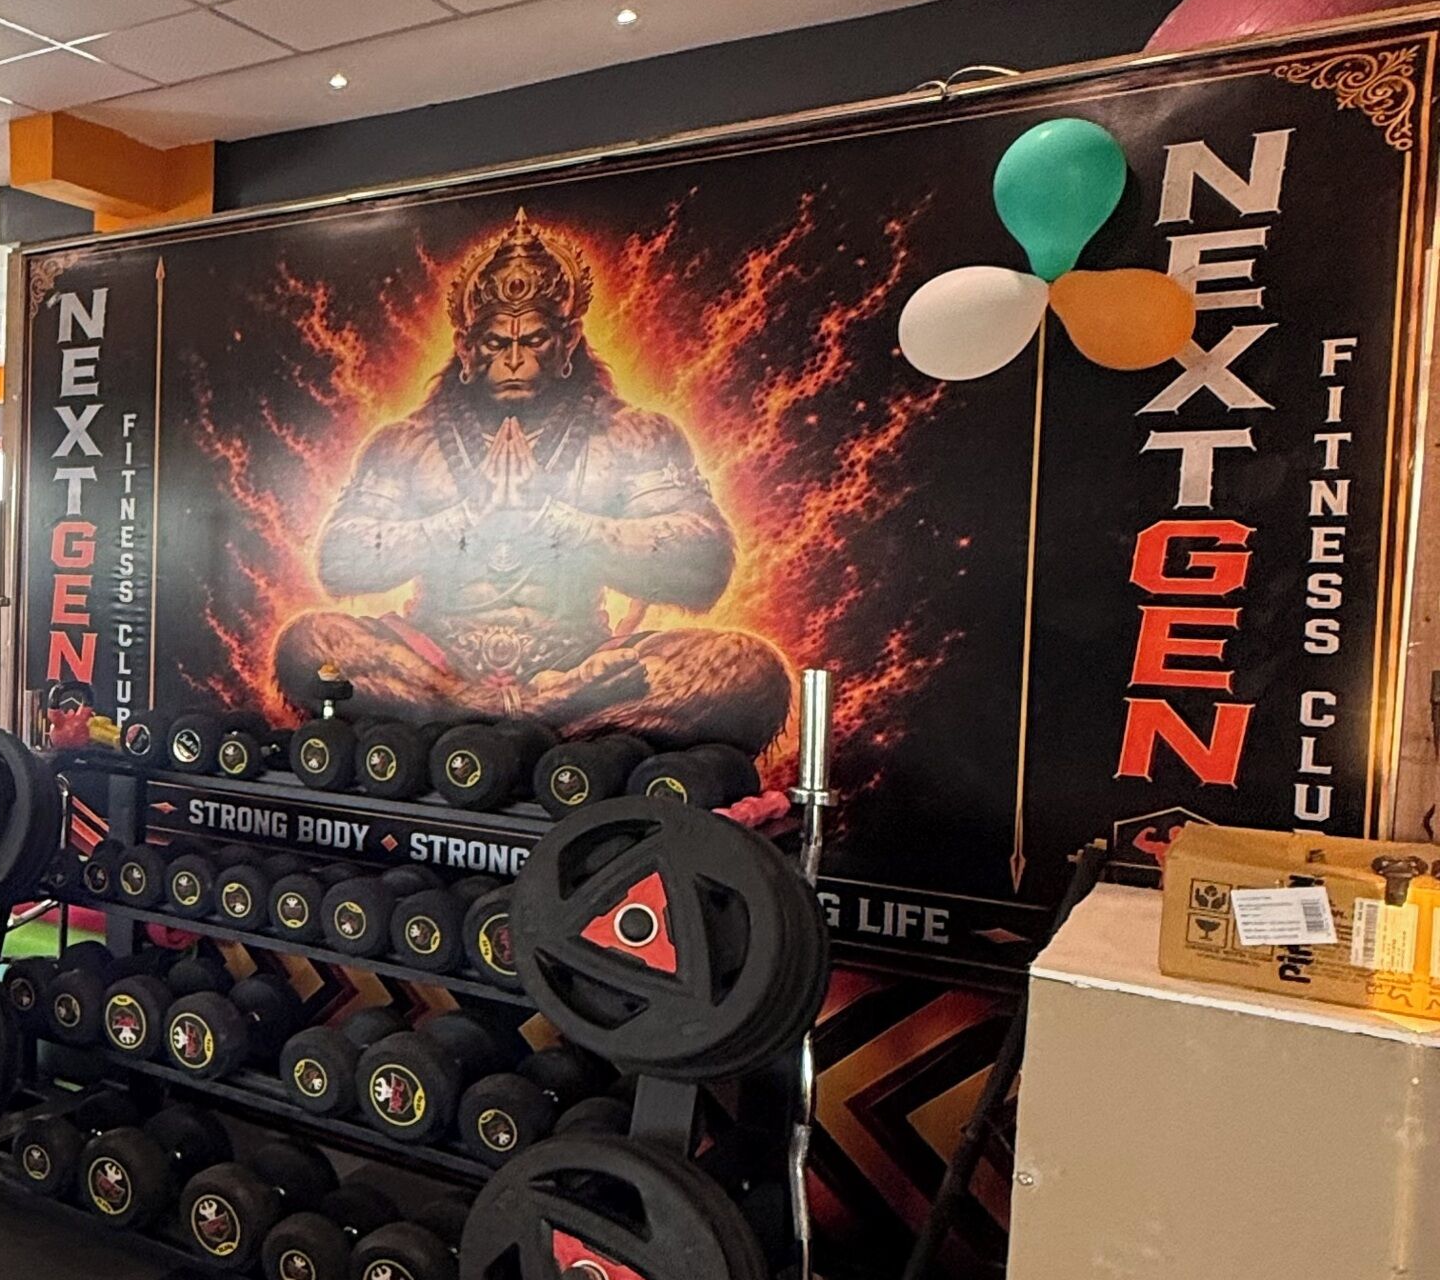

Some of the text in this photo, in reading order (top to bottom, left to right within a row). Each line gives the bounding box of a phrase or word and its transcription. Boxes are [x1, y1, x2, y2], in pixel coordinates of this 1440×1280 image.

[47, 287, 109, 684] NEXTGEN
[117, 413, 137, 604] FITNESS
[1116, 127, 1297, 787] NEXTGEN
[1302, 335, 1357, 656] FITNESS
[189, 798, 530, 876] STRONG BODY STRONG
[1292, 689, 1338, 835] CLU
[857, 896, 950, 945] LIFE
